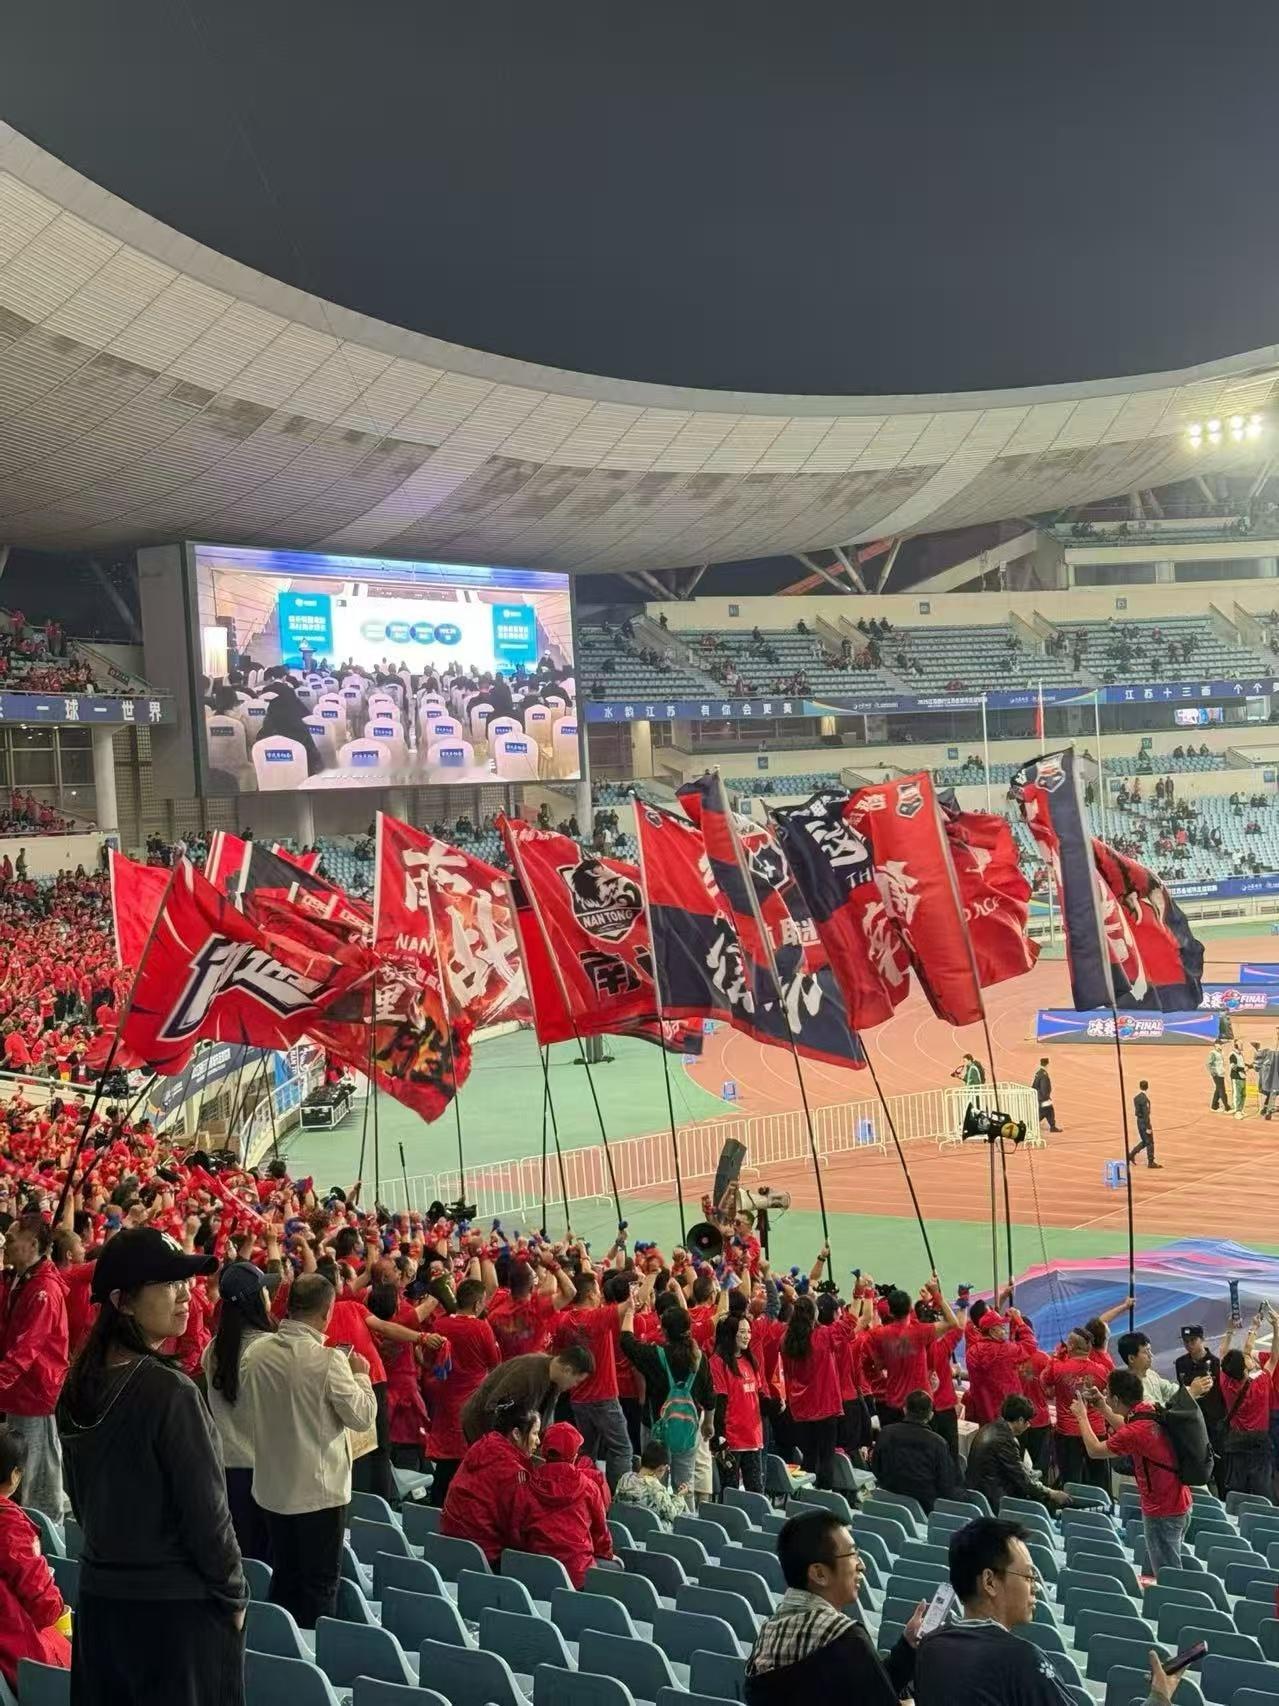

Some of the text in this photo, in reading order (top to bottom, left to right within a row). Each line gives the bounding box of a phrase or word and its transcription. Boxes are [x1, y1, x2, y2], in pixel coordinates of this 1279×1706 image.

[36, 698, 162, 723] 一球一世界
[603, 705, 676, 719] 水韵江苏
[1134, 1020, 1163, 1031] FINAL
